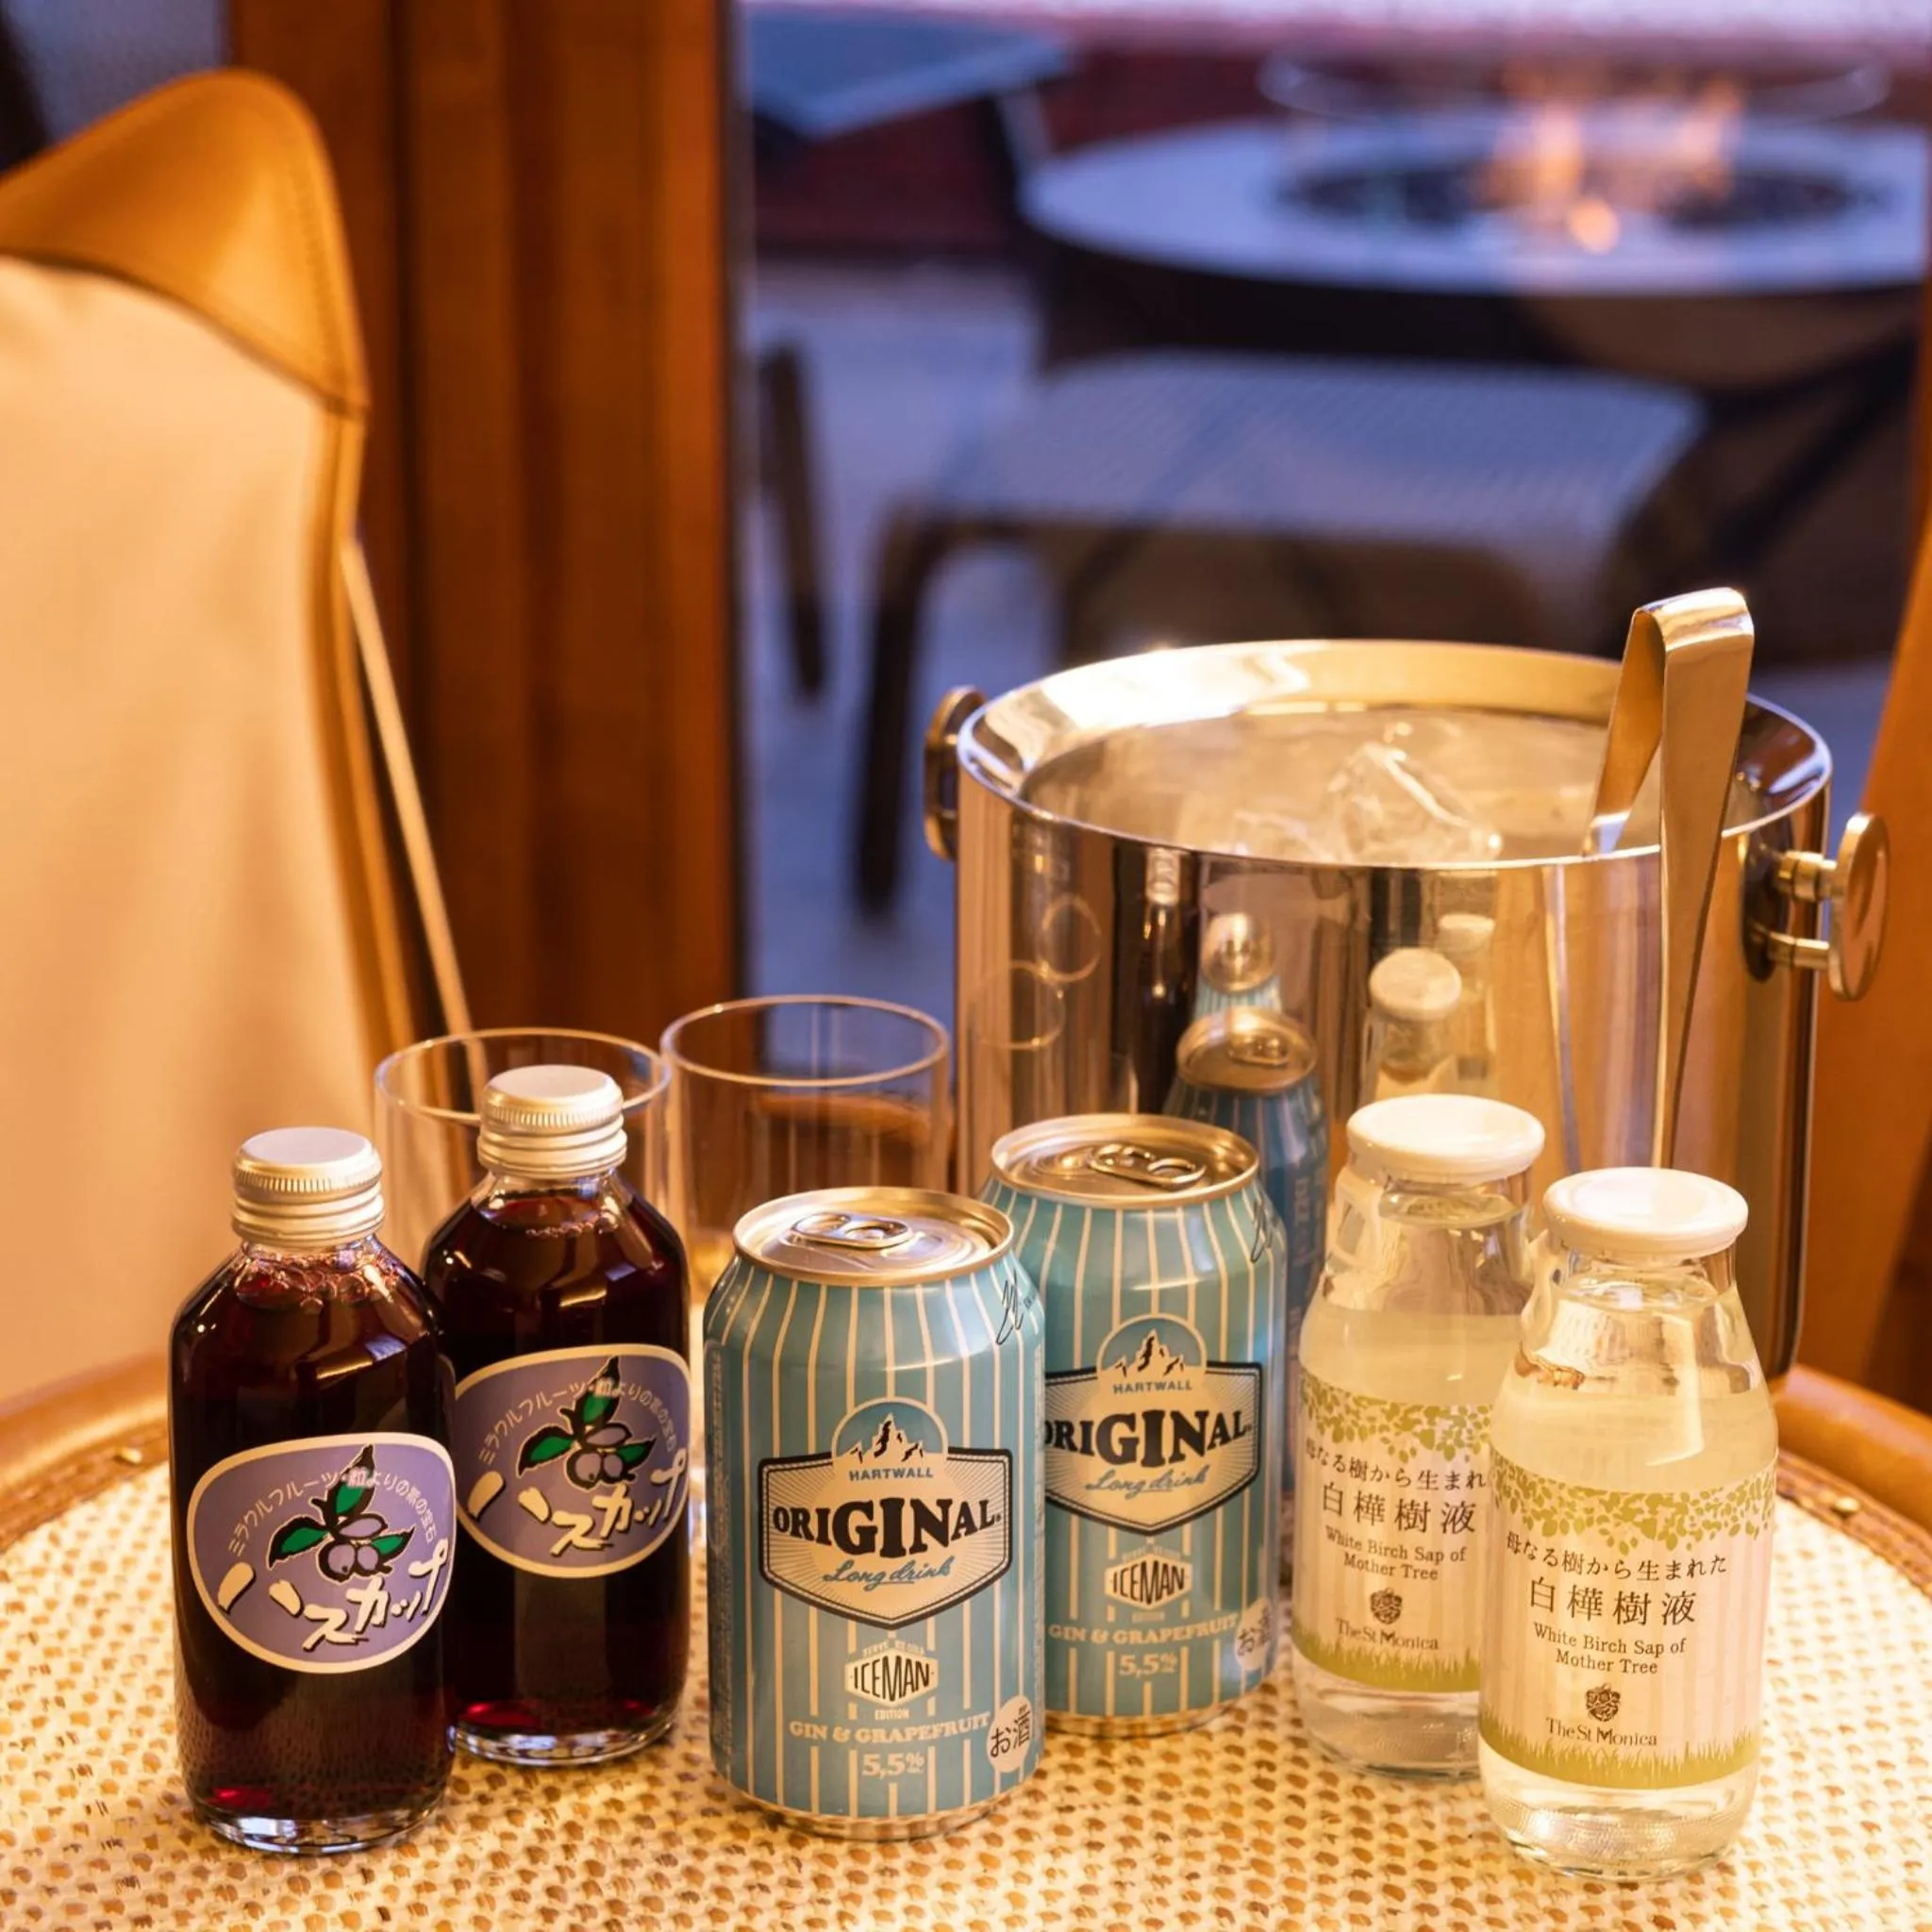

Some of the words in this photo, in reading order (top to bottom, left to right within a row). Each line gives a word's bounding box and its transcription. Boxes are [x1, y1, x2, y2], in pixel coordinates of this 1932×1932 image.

[1113, 1381, 1192, 1394] HARTWALL
[849, 1466, 933, 1481] HARTWALL
[1085, 1469, 1147, 1500] Long
[1150, 1465, 1210, 1490] drink
[467, 1448, 687, 1557] ハスカップ
[1323, 1481, 1476, 1535] 白樺樹液
[773, 1497, 996, 1559] ORIGINAL
[1324, 1525, 1363, 1552] White
[1368, 1539, 1408, 1560] Birch
[1414, 1545, 1444, 1565] Sap
[1450, 1547, 1468, 1562] of
[823, 1559, 886, 1591] Long
[889, 1556, 955, 1580] drink
[1343, 1552, 1396, 1576] Mother
[1402, 1563, 1439, 1581] Tree
[1507, 1531, 1727, 1582] 母なる樹から生まれた
[218, 1538, 449, 1652] ハスカップ
[1113, 1560, 1185, 1605] ICEMAN
[1529, 1576, 1697, 1626] 白樺樹液
[1048, 1624, 1086, 1642] GIN
[1091, 1628, 1108, 1644] &
[1113, 1612, 1239, 1644] GRAPEFRUIT
[1379, 1631, 1440, 1651] Monica
[1533, 1622, 1576, 1647] White
[1583, 1634, 1627, 1654] Birch
[1634, 1640, 1664, 1658] Sap
[1670, 1638, 1687, 1654] of
[1556, 1648, 1614, 1673] Mother
[1619, 1658, 1658, 1674] Tree
[854, 1656, 930, 1702] ICEMAN
[790, 1721, 827, 1741] GIN
[832, 1726, 850, 1742] &
[855, 1711, 991, 1743] GRAPEFRUIT
[991, 1710, 1030, 1758] お酒
[1596, 1728, 1657, 1745] Monica
[862, 1751, 925, 1780] 5,5%
